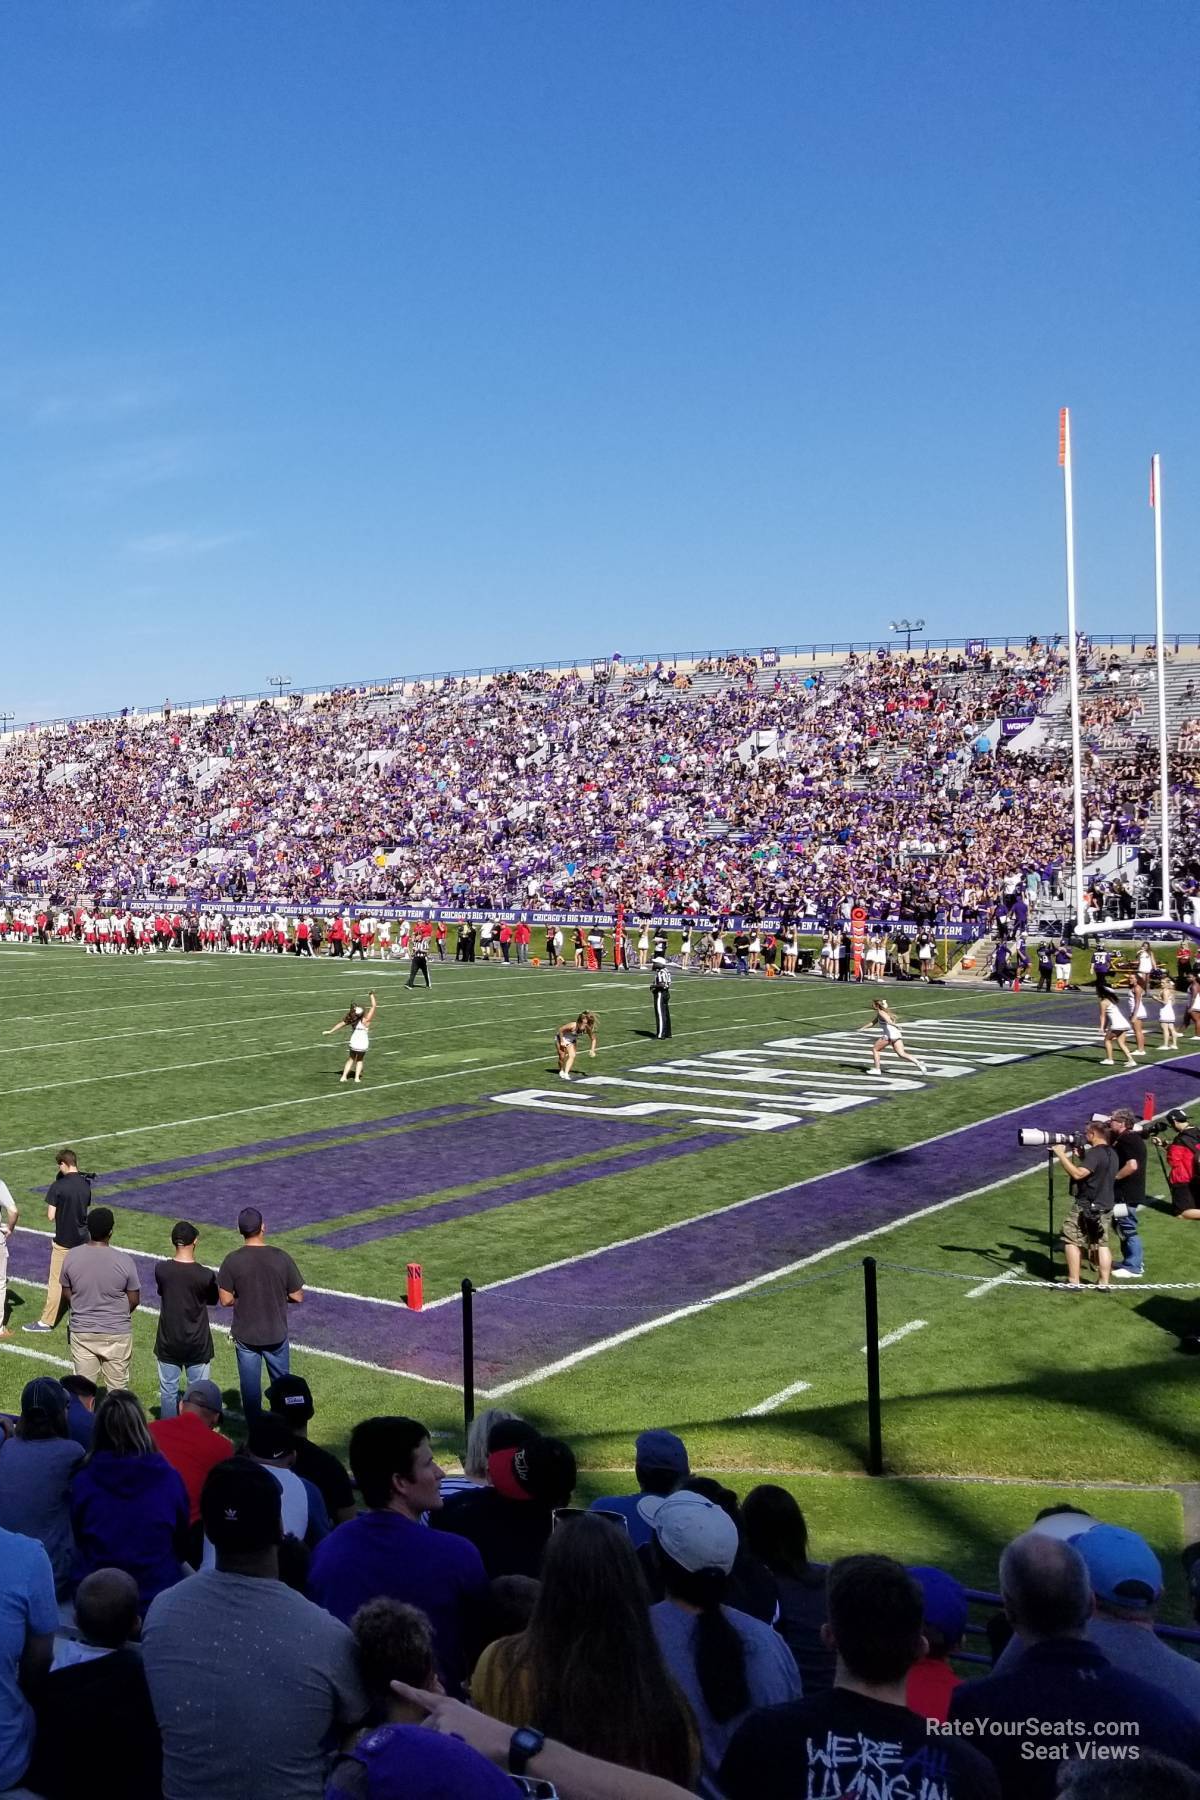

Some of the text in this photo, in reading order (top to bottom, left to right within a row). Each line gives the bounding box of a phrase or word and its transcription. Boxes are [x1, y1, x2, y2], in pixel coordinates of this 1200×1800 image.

[355, 908, 383, 917] CHICAGO'S
[384, 909, 394, 917] BIG
[395, 909, 407, 917] TEN
[407, 910, 424, 918] TEAM
[429, 910, 515, 921] N CHICAGO'S BIG TEN TEAM
[520, 912, 613, 924] N CHICAGO'S BIG TEN TEAM
[669, 917, 682, 926] BIG
[843, 922, 851, 933] N
[903, 924, 918, 935] BIG
[938, 926, 963, 936] TEAM
[1094, 954, 1106, 965] 94
[806, 1730, 904, 1772] WE'RE
